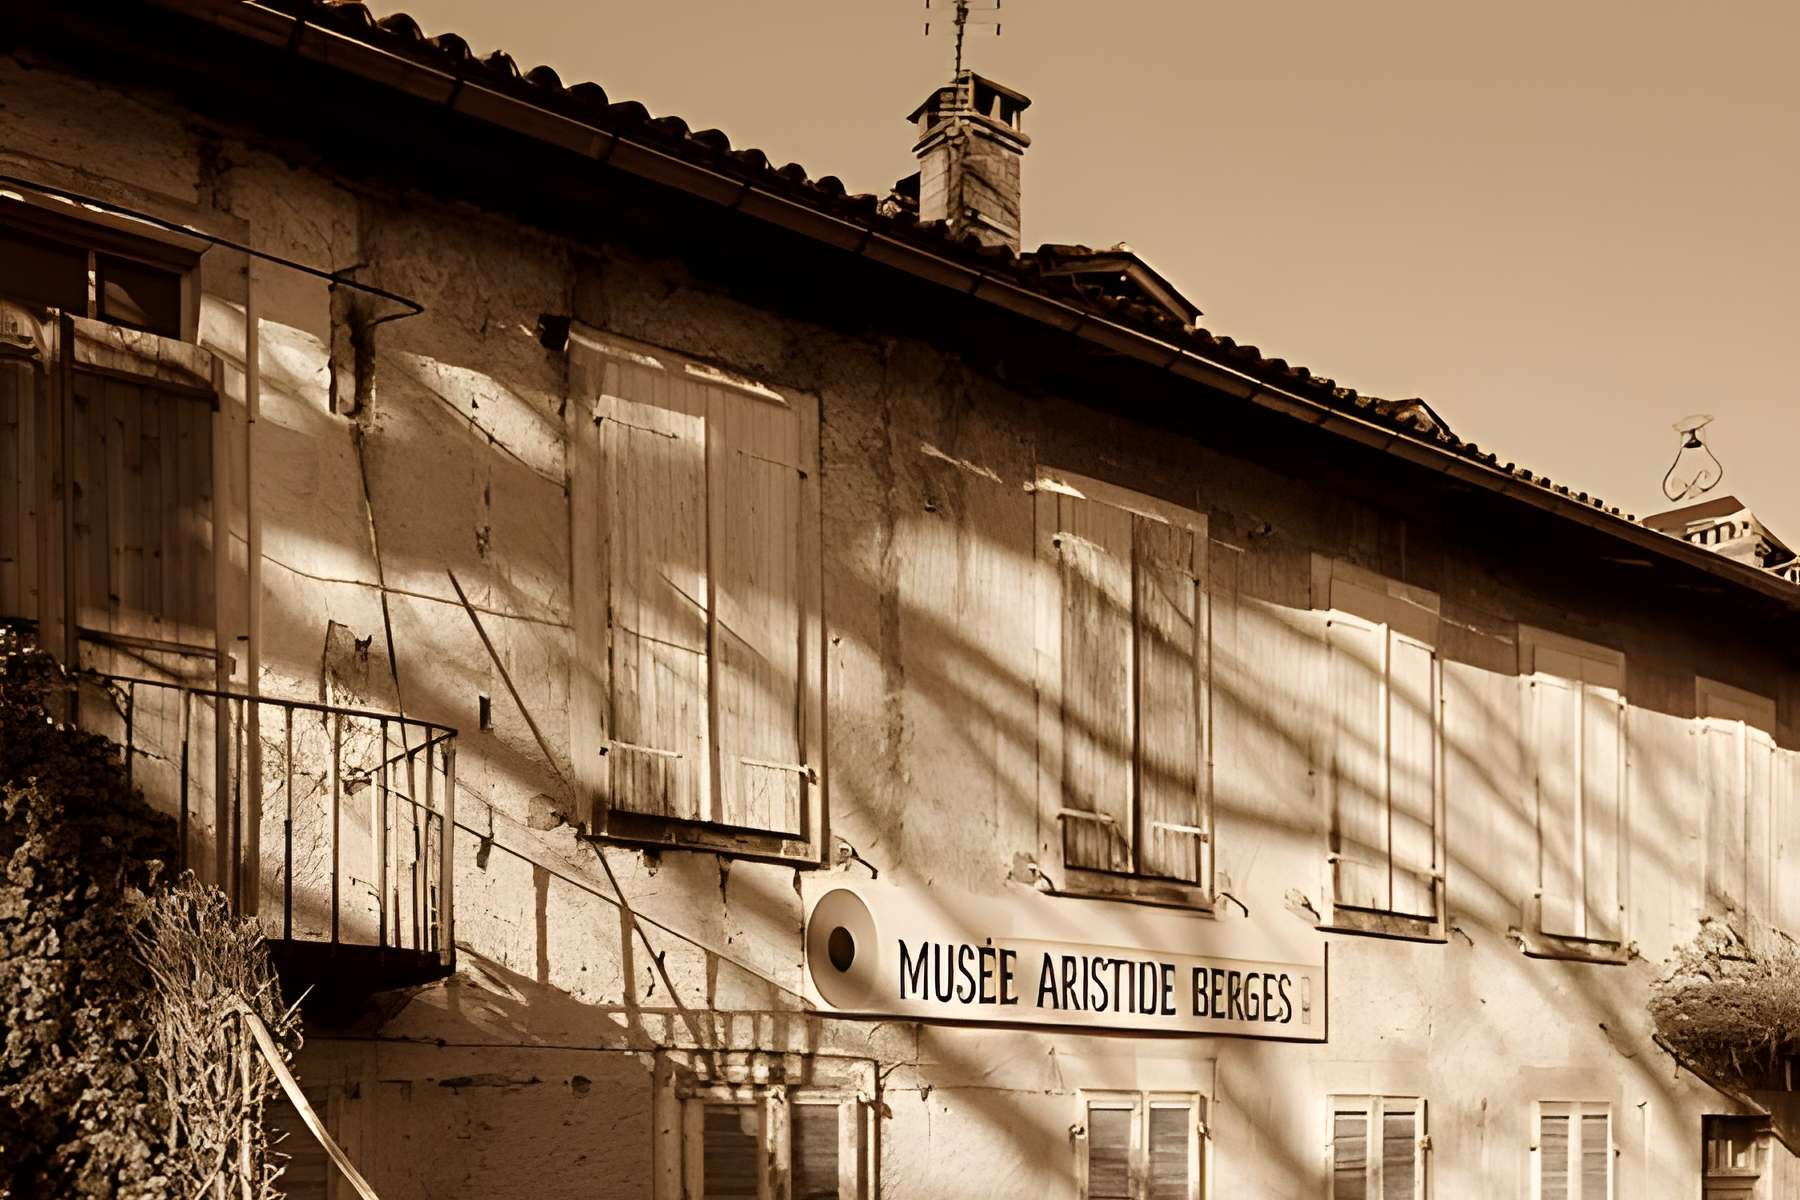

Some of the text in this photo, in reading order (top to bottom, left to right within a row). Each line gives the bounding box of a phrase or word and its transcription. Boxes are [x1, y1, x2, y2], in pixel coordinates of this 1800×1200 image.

[898, 937, 1292, 1023] MUSÉE ARISTIDE BERGES
